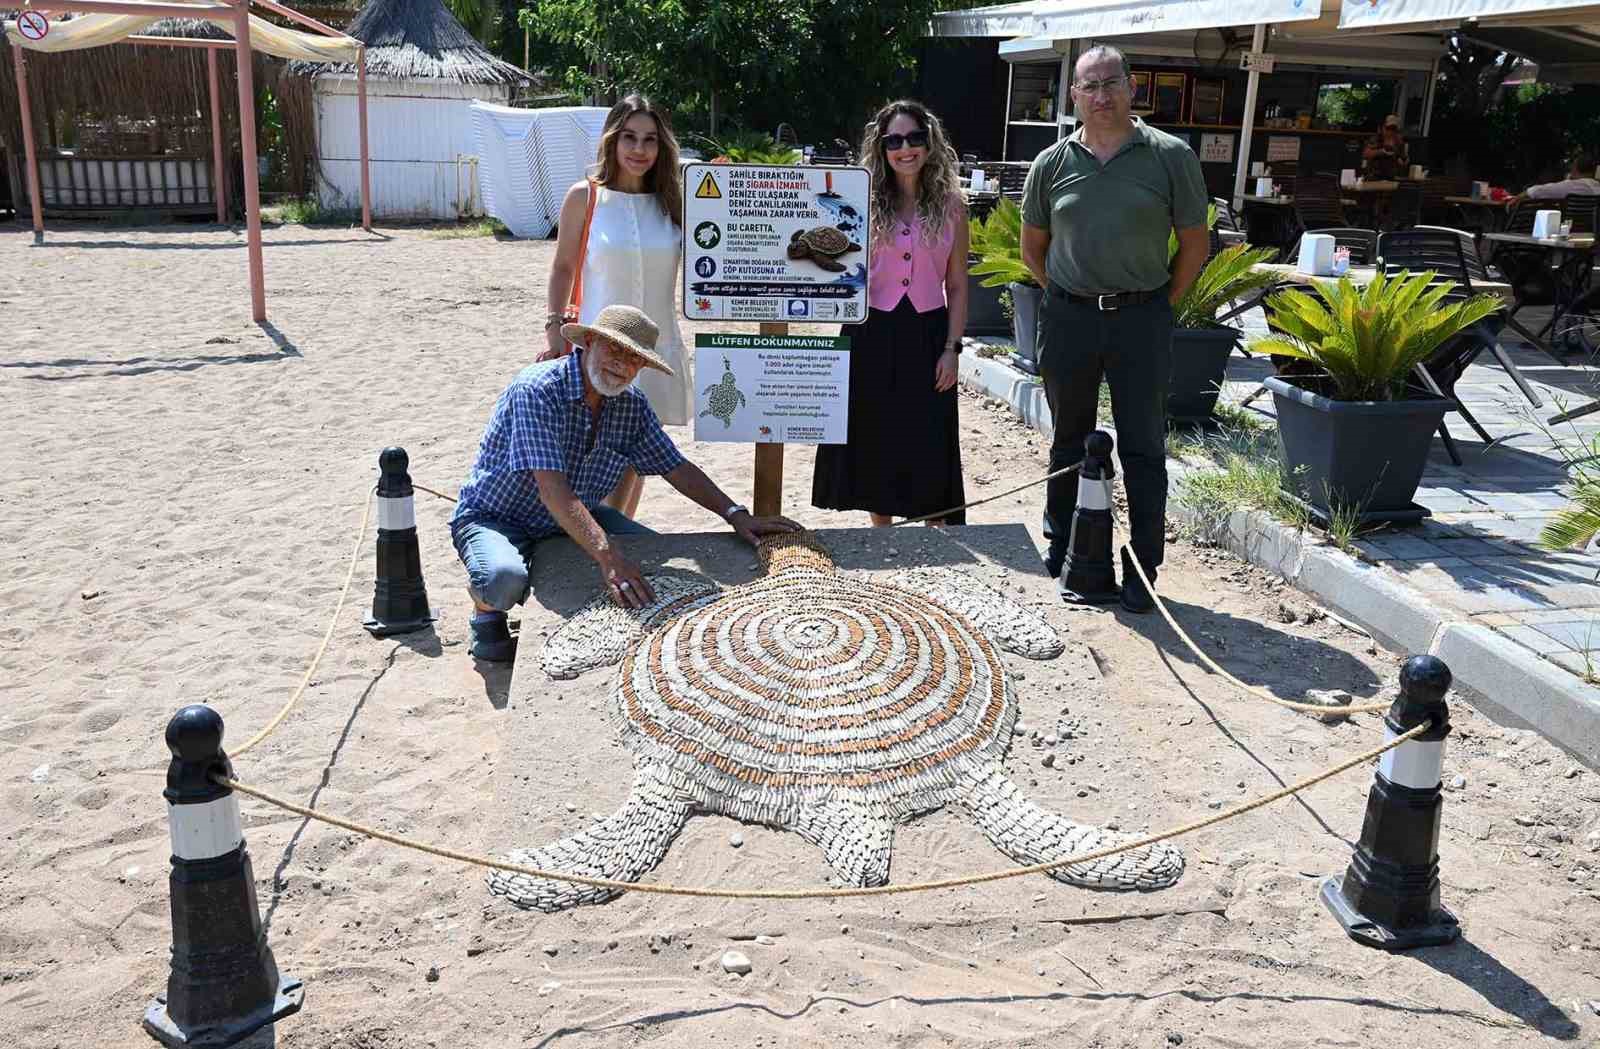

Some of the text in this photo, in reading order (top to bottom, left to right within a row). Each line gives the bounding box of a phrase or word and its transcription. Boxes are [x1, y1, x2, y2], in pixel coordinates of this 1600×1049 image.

[729, 169, 804, 180] SAHİLE BIRAKTIĞIN
[729, 180, 744, 188] HER
[746, 180, 774, 189] SİGARA
[729, 190, 799, 200] DENİZE ULAŞARAK
[729, 199, 808, 209] DENİZ CANLILARININ
[729, 209, 820, 219] YAŞAMINA ZARAR VERİR.
[740, 224, 775, 232] CARETTA,
[723, 266, 737, 274] ÇÖP
[712, 335, 834, 348] LÜTFEN DOKUNMAYINIZ
